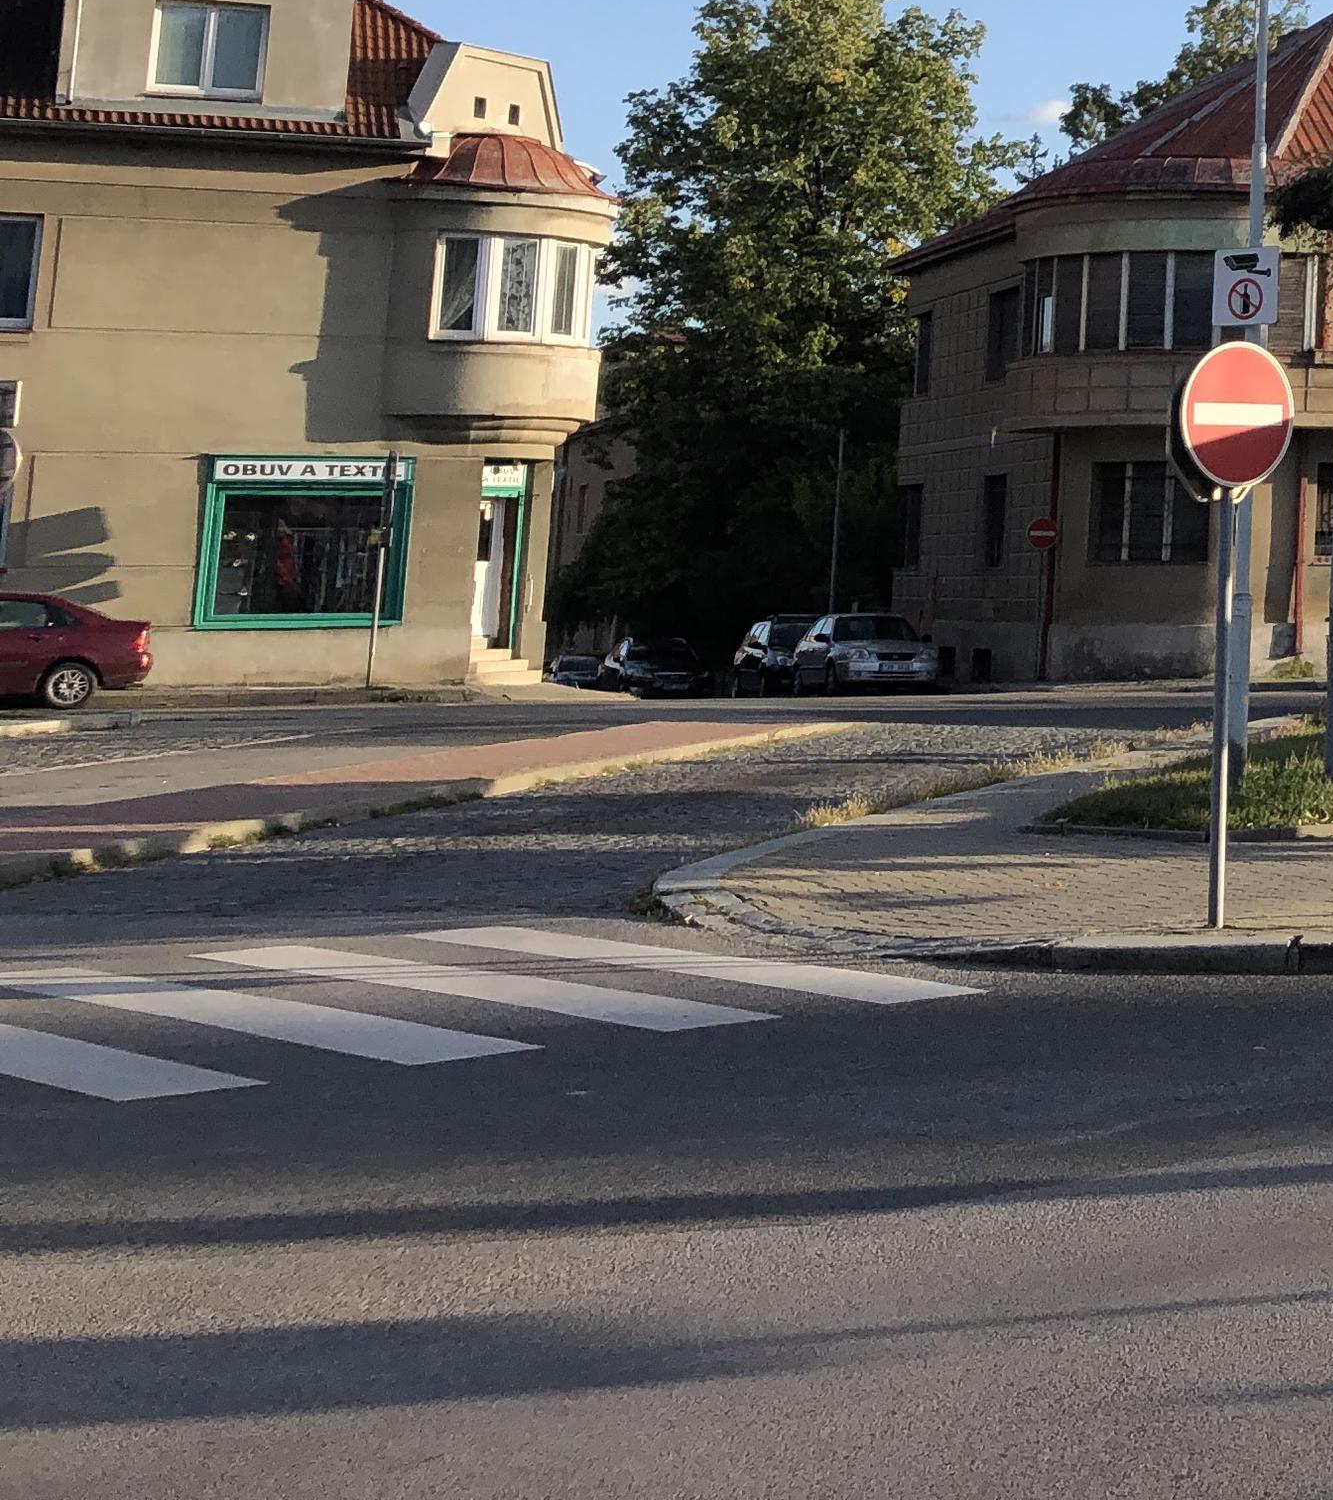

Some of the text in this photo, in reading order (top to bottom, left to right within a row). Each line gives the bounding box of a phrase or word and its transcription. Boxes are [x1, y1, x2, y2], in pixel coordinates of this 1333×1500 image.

[222, 463, 402, 477] OBUV A TEXTI
